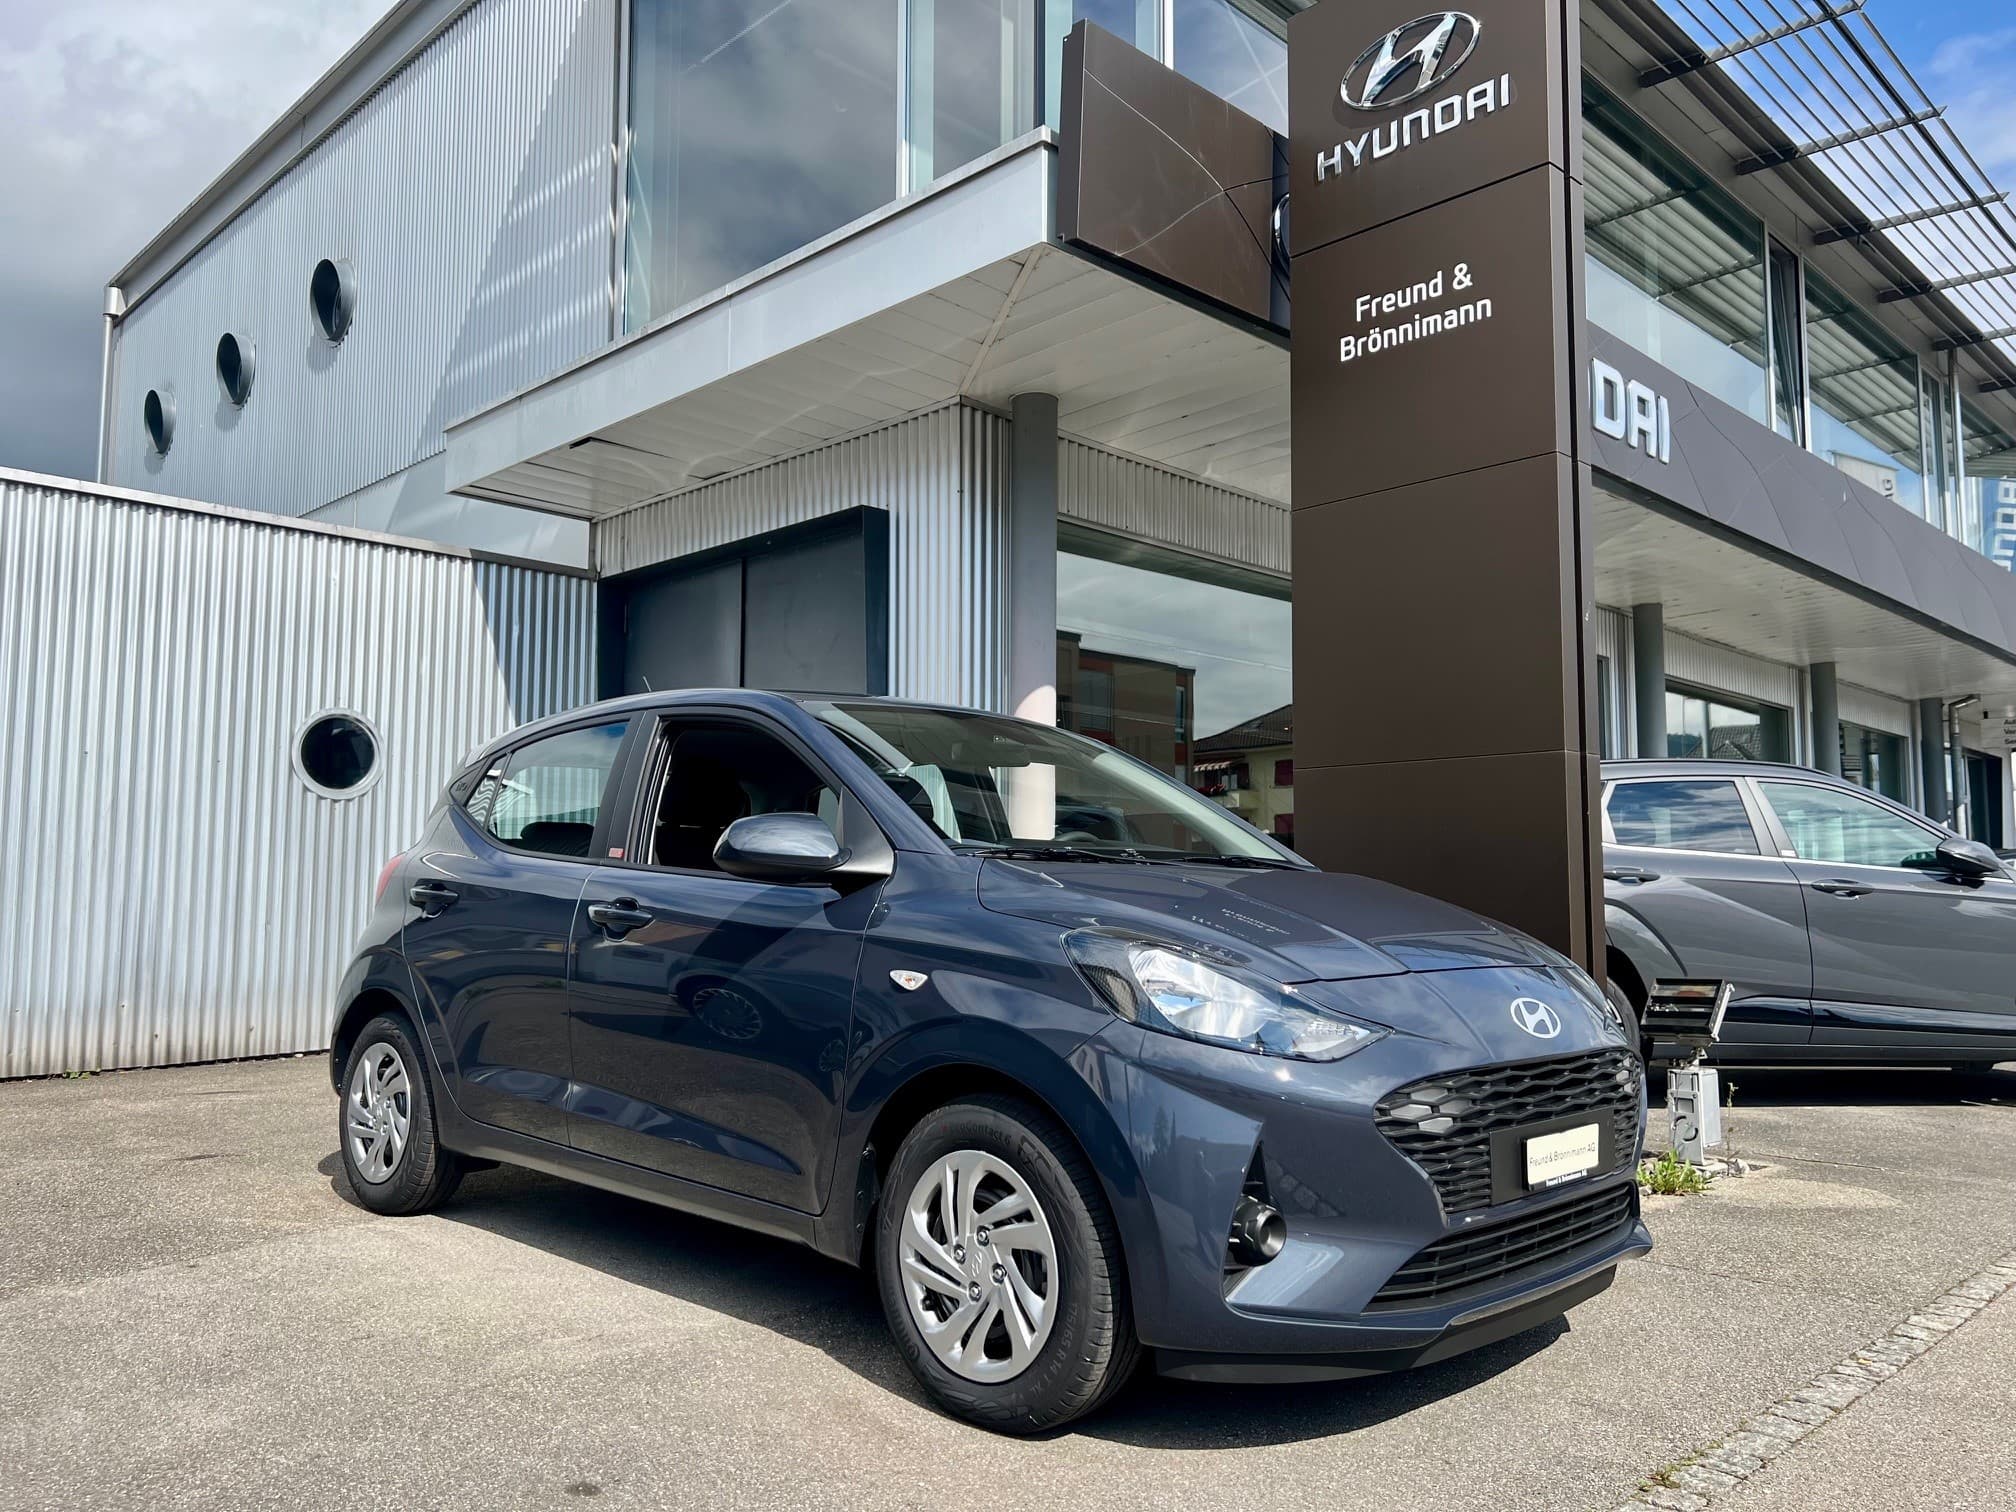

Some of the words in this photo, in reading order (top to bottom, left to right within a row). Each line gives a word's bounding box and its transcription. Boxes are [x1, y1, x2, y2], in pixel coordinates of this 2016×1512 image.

[1316, 73, 1510, 182] HYUNDAI
[1340, 298, 1492, 363] Brönnimann
[1356, 270, 1443, 322] Freund
[1451, 262, 1473, 291] &
[1588, 357, 1670, 465] DAI
